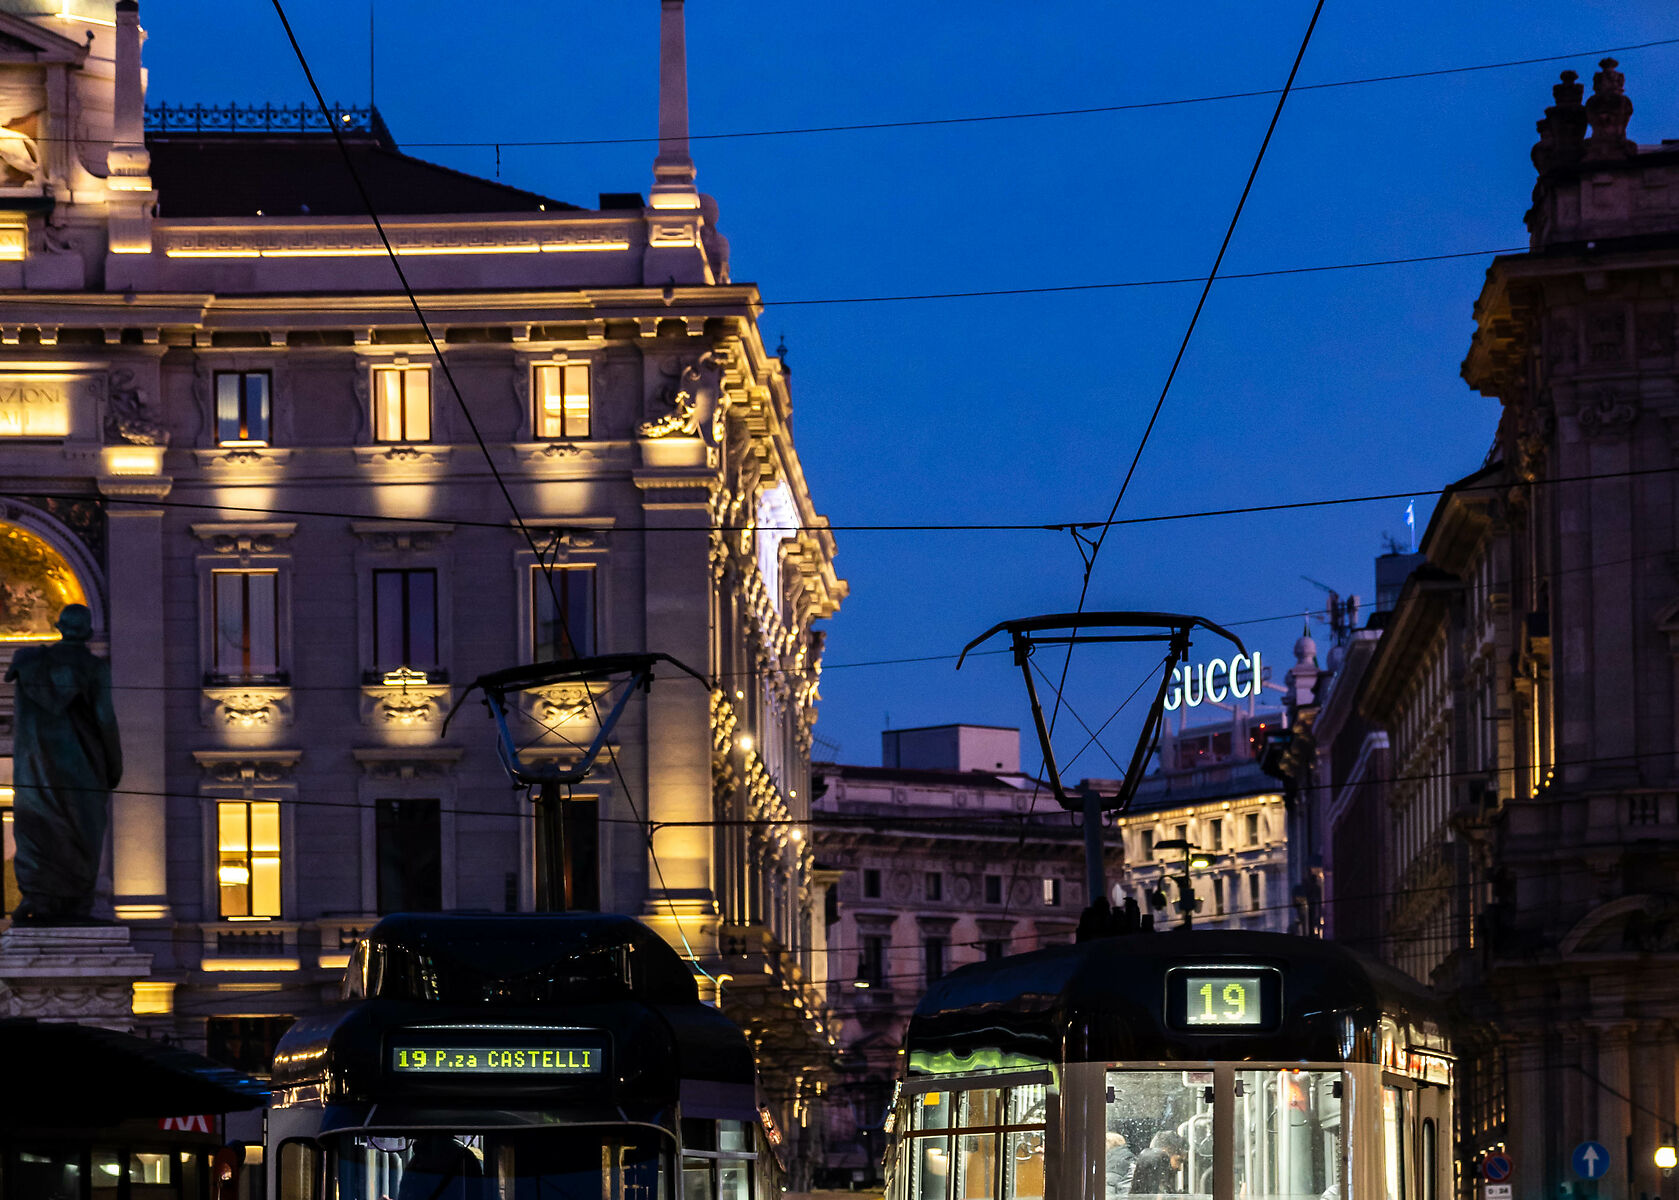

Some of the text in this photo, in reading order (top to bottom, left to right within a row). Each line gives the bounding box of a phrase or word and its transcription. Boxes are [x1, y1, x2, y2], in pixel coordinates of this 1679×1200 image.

[1163, 651, 1262, 711] GUCCI
[1200, 983, 1246, 1021] 19
[398, 1050, 592, 1068] 19 P.za CASTELLI
